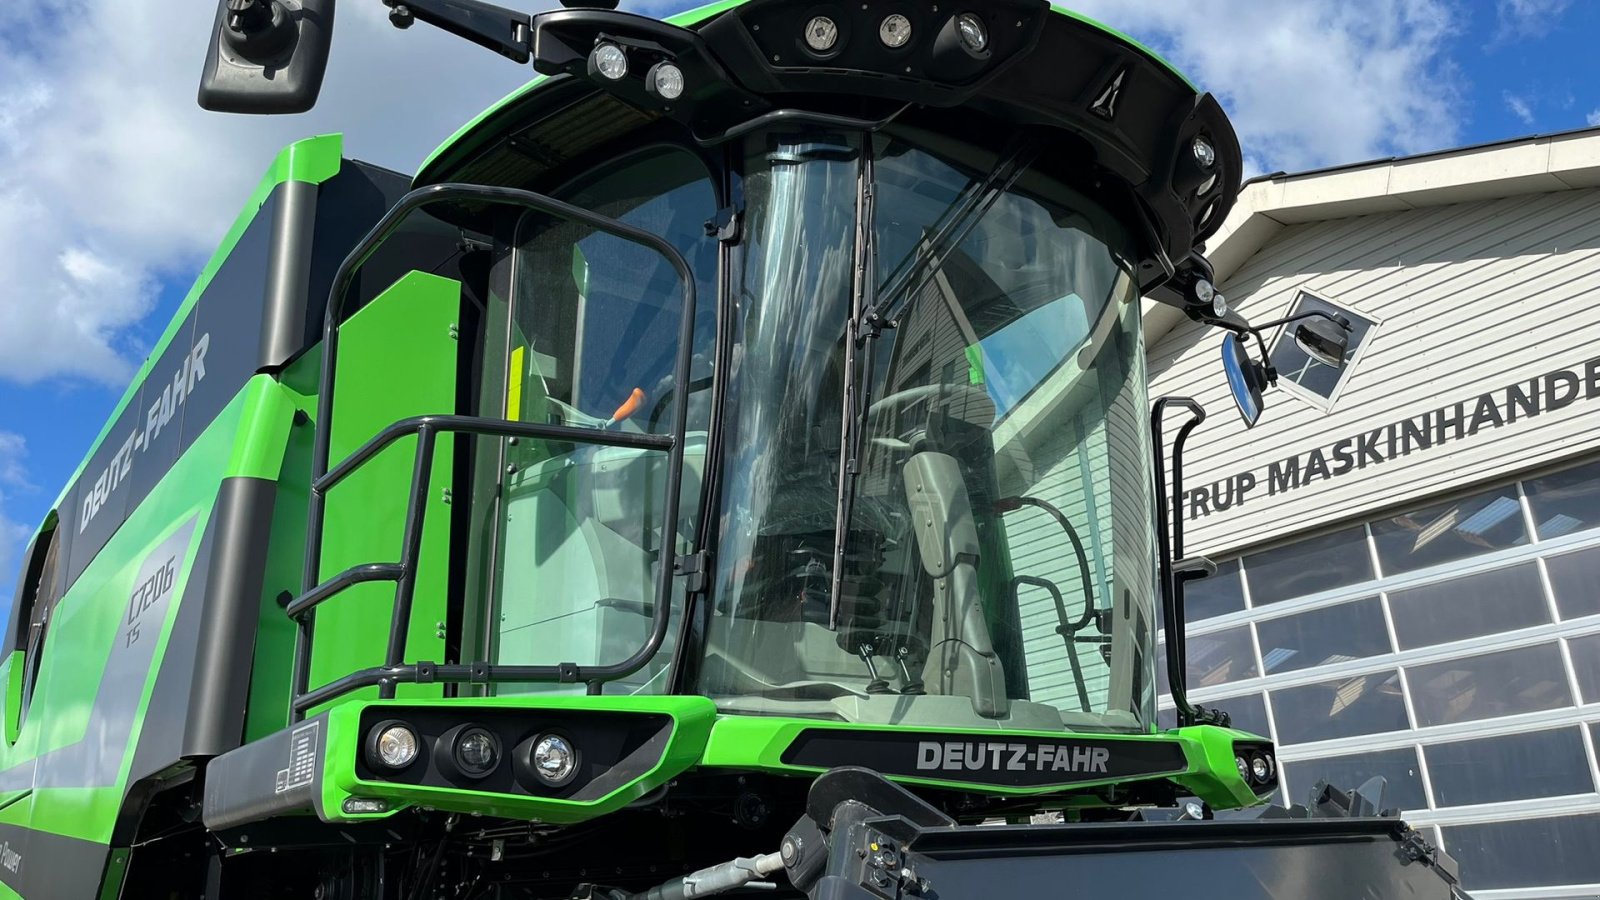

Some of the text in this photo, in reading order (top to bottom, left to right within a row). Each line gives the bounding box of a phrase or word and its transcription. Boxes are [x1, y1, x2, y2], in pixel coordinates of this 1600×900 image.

[80, 332, 210, 535] DEUTZ-FAHR
[128, 555, 176, 626] C7206
[126, 622, 141, 649] TS
[916, 741, 1110, 773] DEUTZ-FAHR
